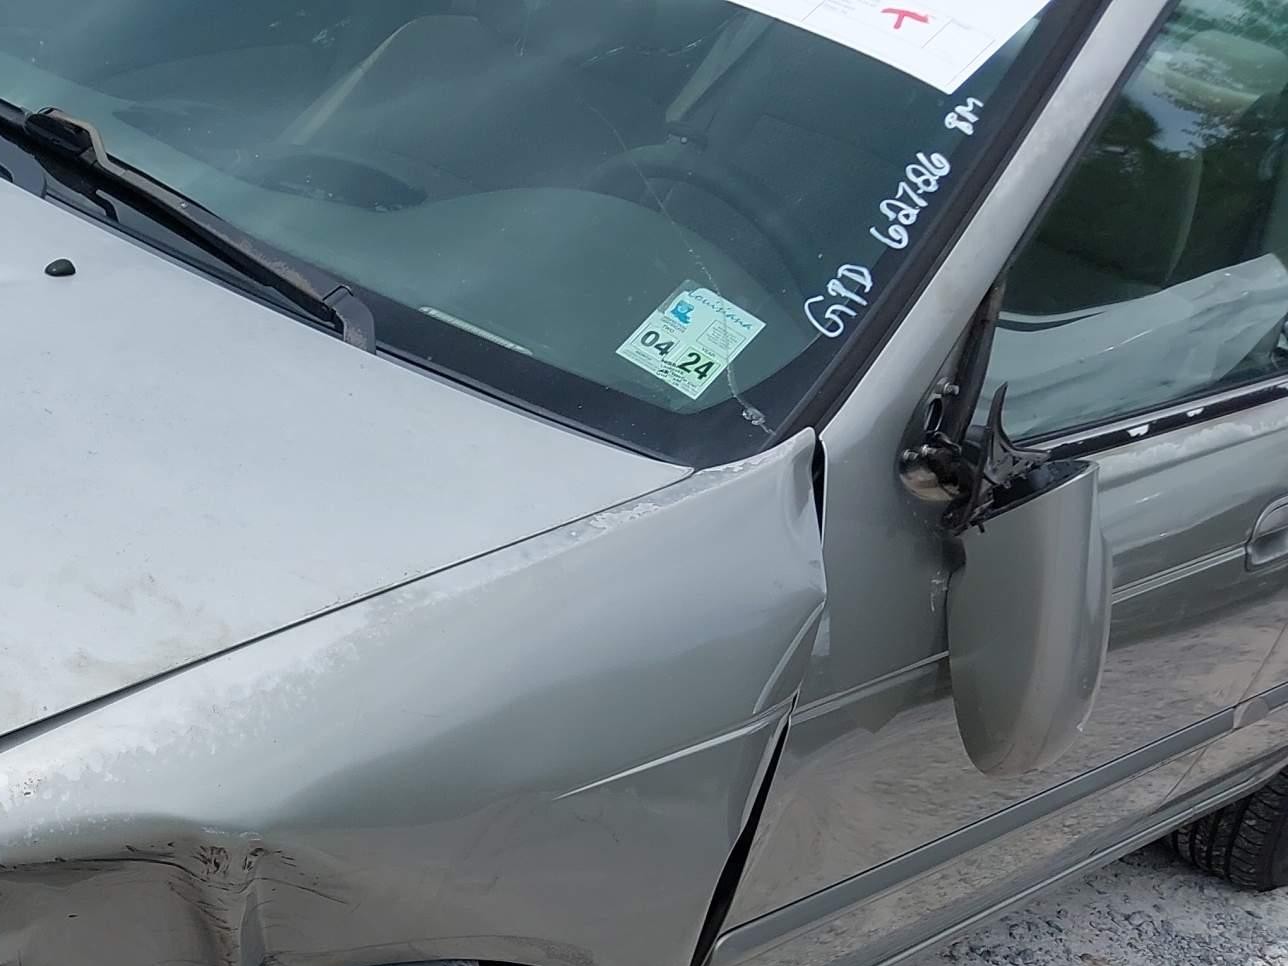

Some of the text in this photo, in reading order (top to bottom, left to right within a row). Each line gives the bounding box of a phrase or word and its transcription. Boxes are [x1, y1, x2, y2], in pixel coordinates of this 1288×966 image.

[688, 290, 753, 331] Louisiana
[640, 330, 674, 356] 04
[677, 352, 715, 380] 24
